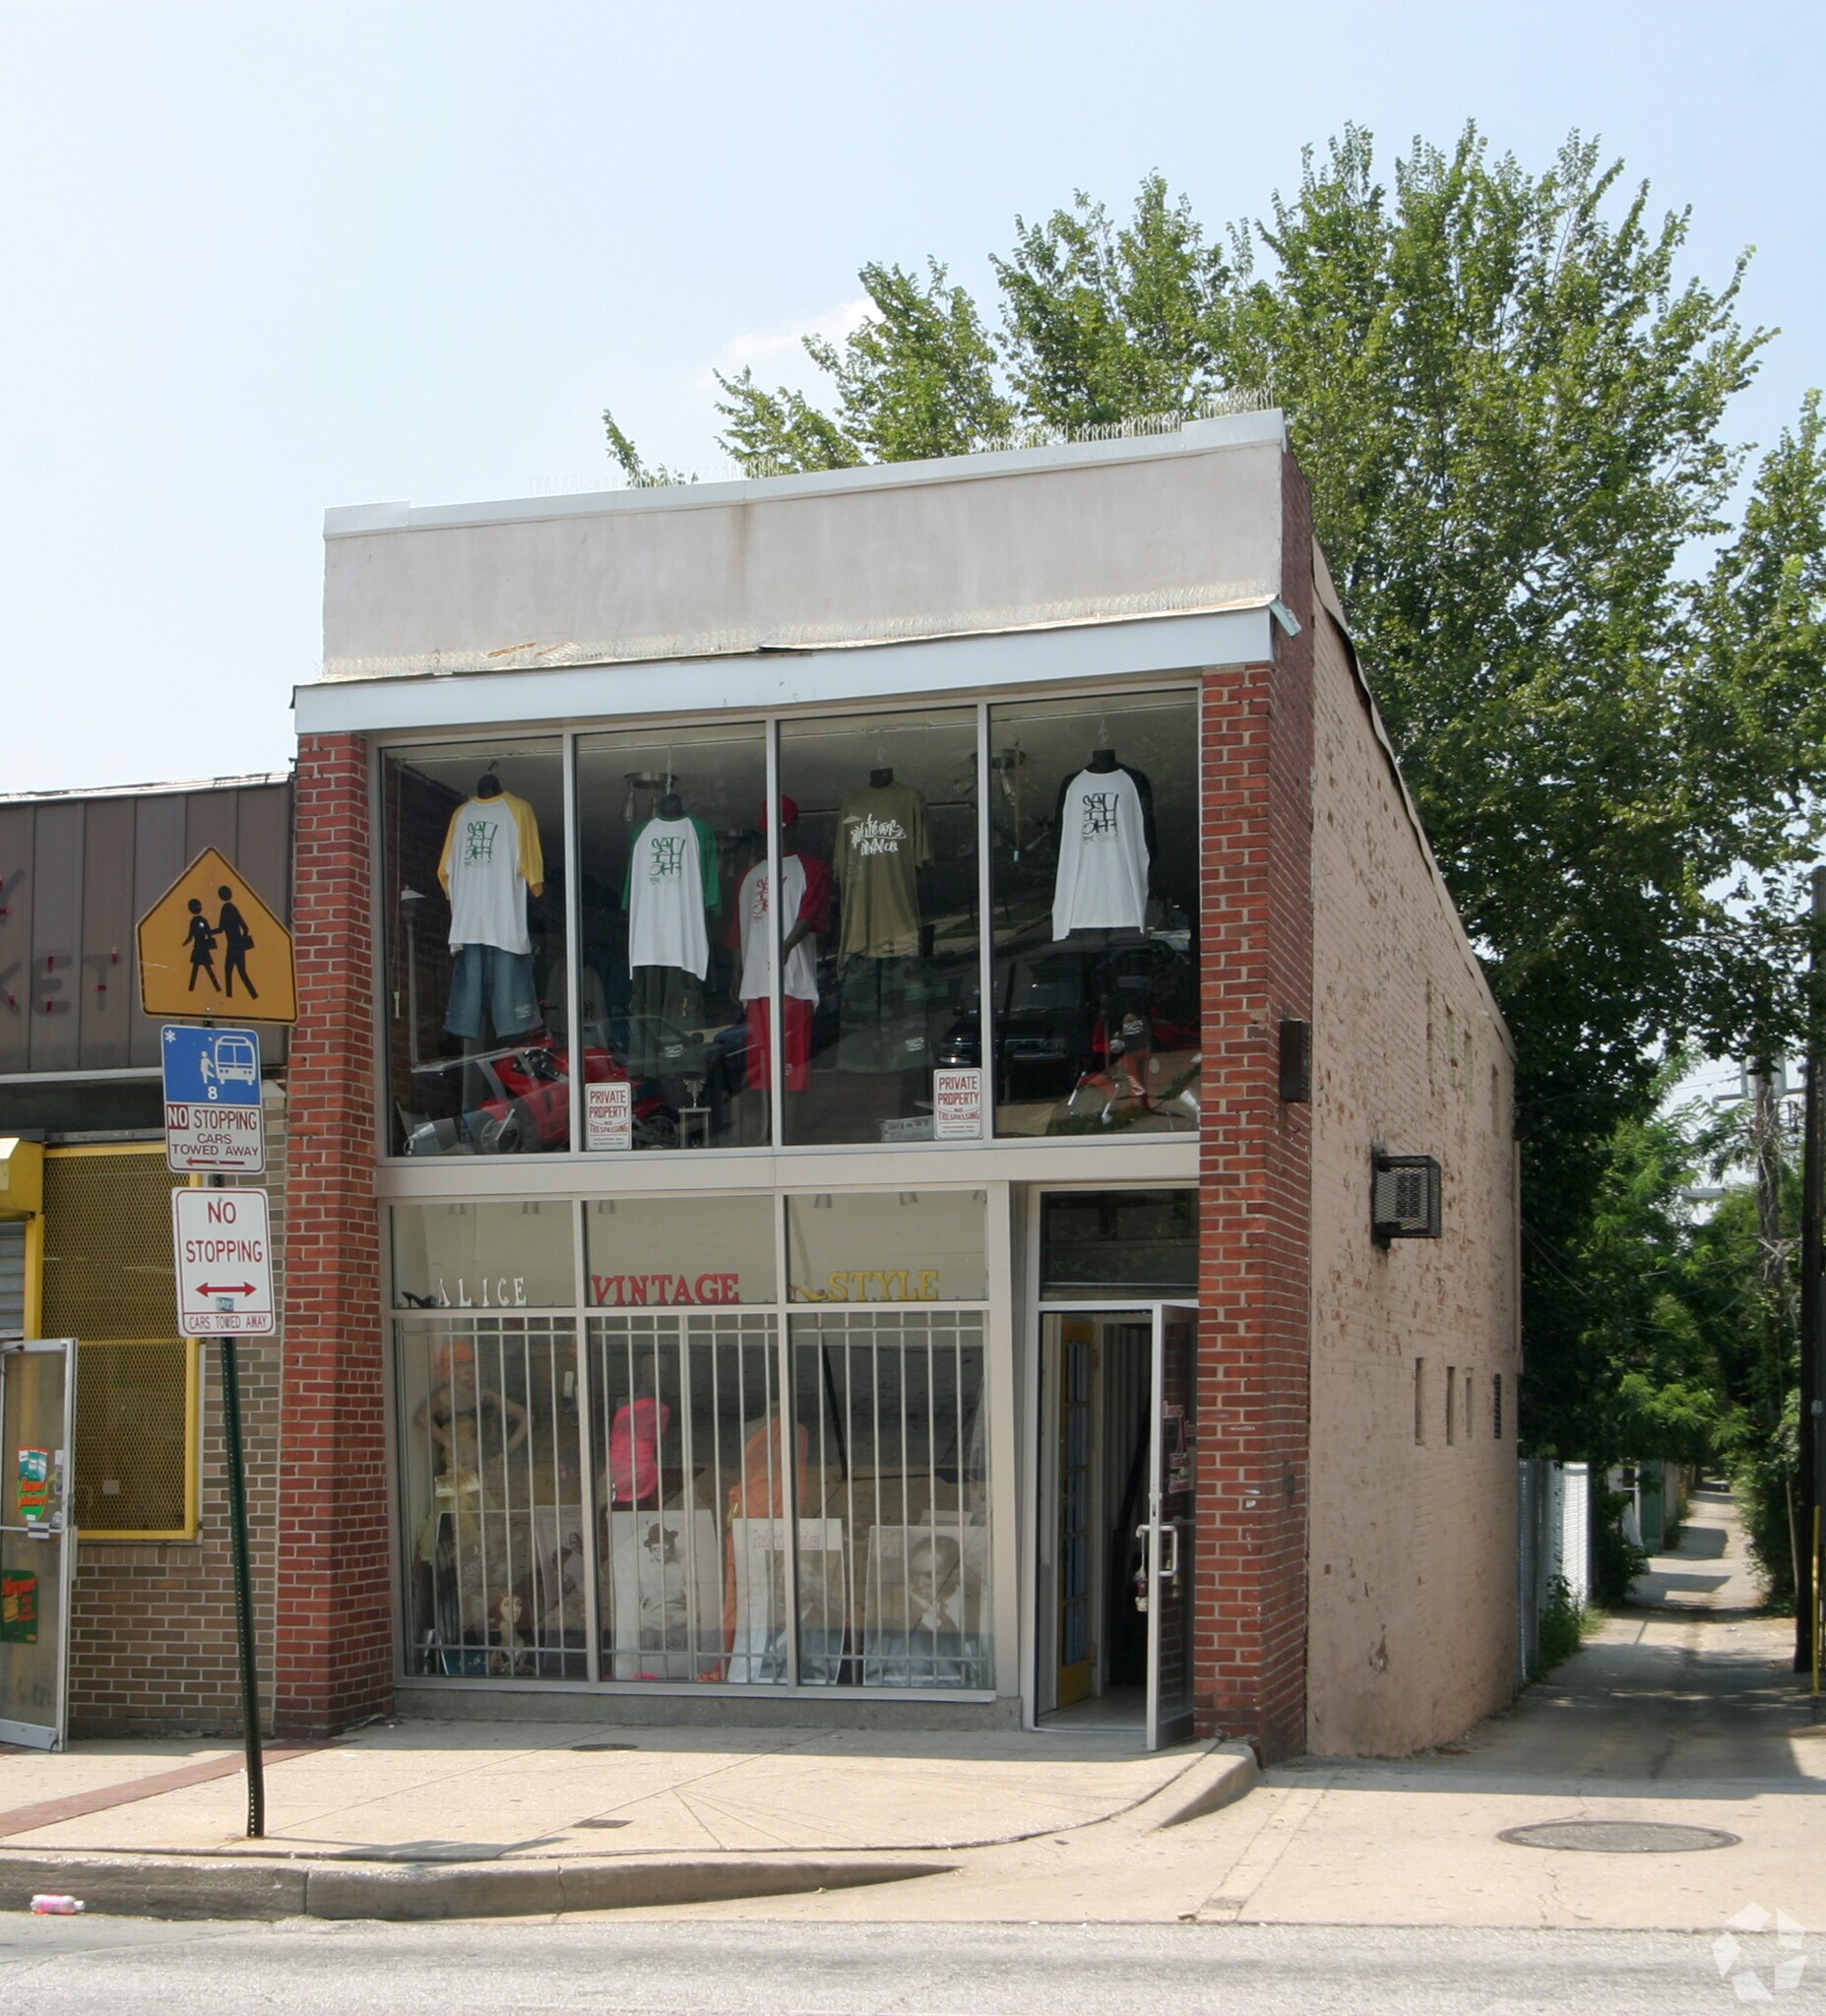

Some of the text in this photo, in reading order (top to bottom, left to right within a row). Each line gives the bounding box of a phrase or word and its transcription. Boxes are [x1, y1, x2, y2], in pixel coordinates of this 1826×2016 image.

[938, 1076, 977, 1091] PRIVATE
[208, 1086, 219, 1101] 8
[590, 1091, 626, 1103] PRIVATE
[937, 1092, 980, 1105] PROPERTY
[167, 1106, 257, 1131] NO STOPPING
[589, 1105, 628, 1119] PROPERTY
[197, 1133, 232, 1144] CARS
[171, 1144, 259, 1157] TOWED AWAY
[208, 1201, 236, 1225] NO
[186, 1239, 263, 1263] STOPPING
[438, 1269, 939, 1307] ALICE VINTAGE STYLE
[189, 1314, 268, 1330] CARS TOWED AWAY
